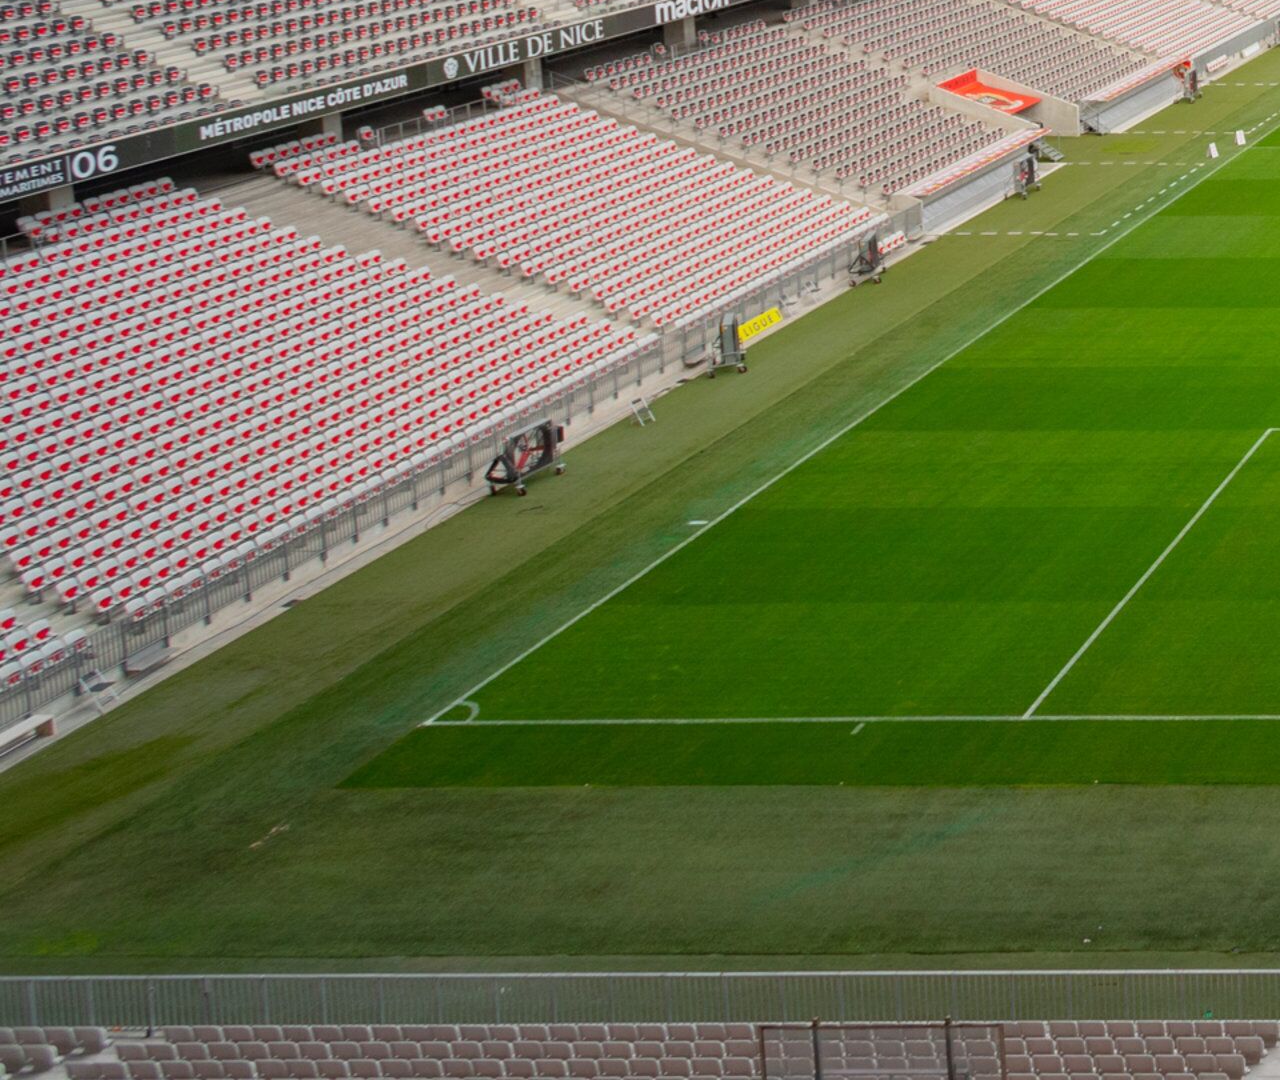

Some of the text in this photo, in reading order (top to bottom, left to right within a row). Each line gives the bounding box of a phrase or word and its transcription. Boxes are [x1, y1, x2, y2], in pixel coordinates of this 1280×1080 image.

[464, 19, 605, 73] VILLE DE NICE
[201, 74, 409, 141] MÉTROPOLE NICE CÔTE D'AZUR
[71, 144, 119, 179] 06
[742, 314, 774, 337] LIGUE
